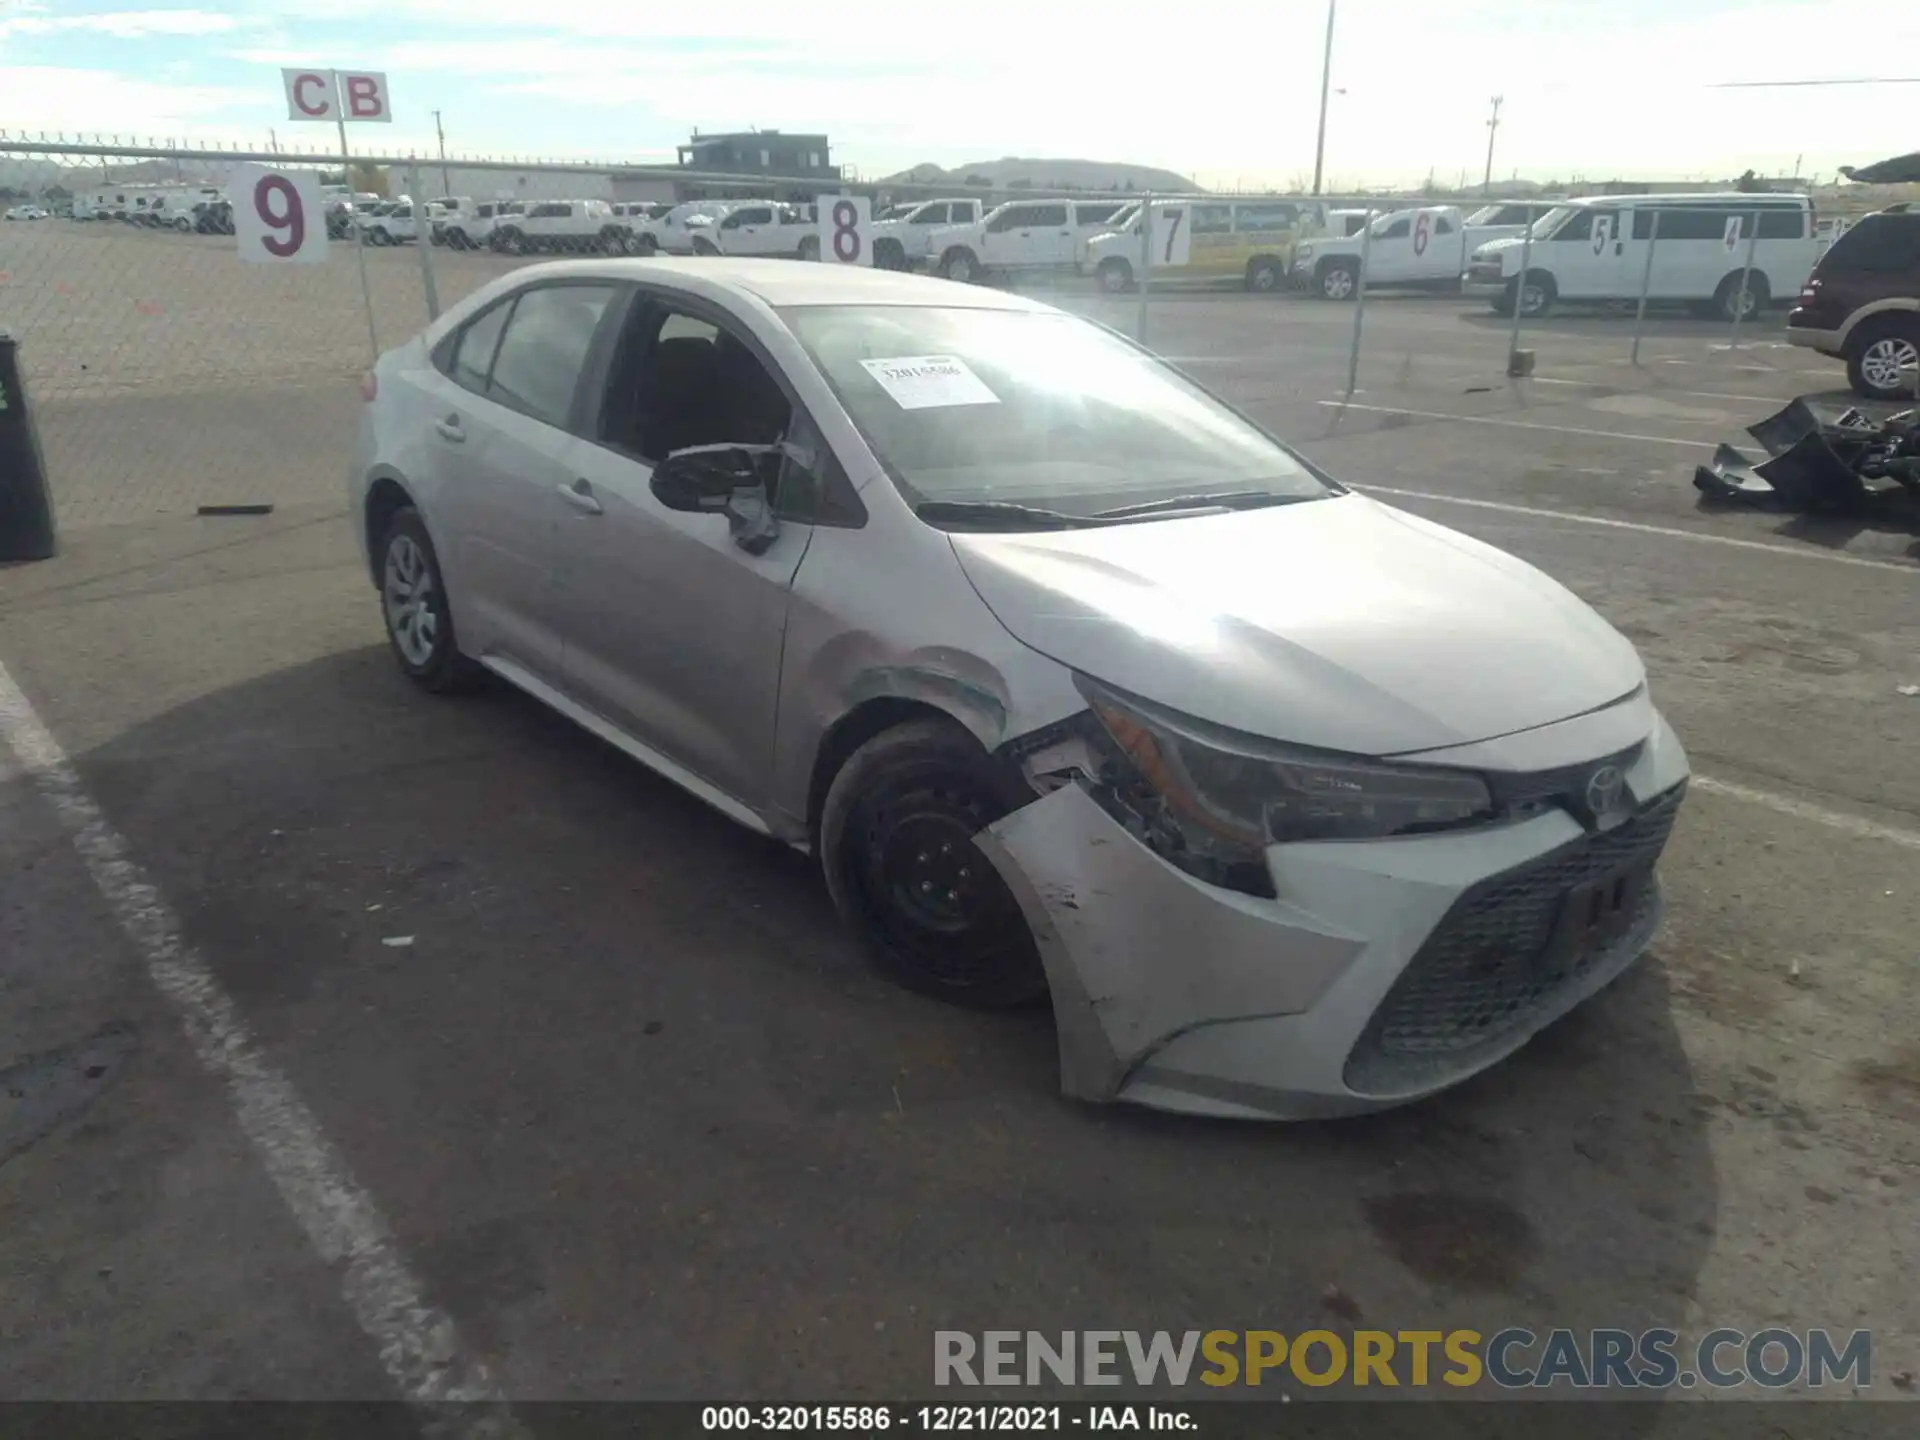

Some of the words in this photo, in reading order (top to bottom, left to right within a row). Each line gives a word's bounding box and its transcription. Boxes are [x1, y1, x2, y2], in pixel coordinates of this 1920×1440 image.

[294, 74, 329, 116] C
[347, 76, 382, 118] B
[254, 173, 305, 258] 9
[832, 199, 860, 263] 8
[1162, 208, 1183, 264] 7
[1413, 213, 1431, 257] 6
[1592, 216, 1610, 256] 5
[1725, 215, 1739, 252] 4
